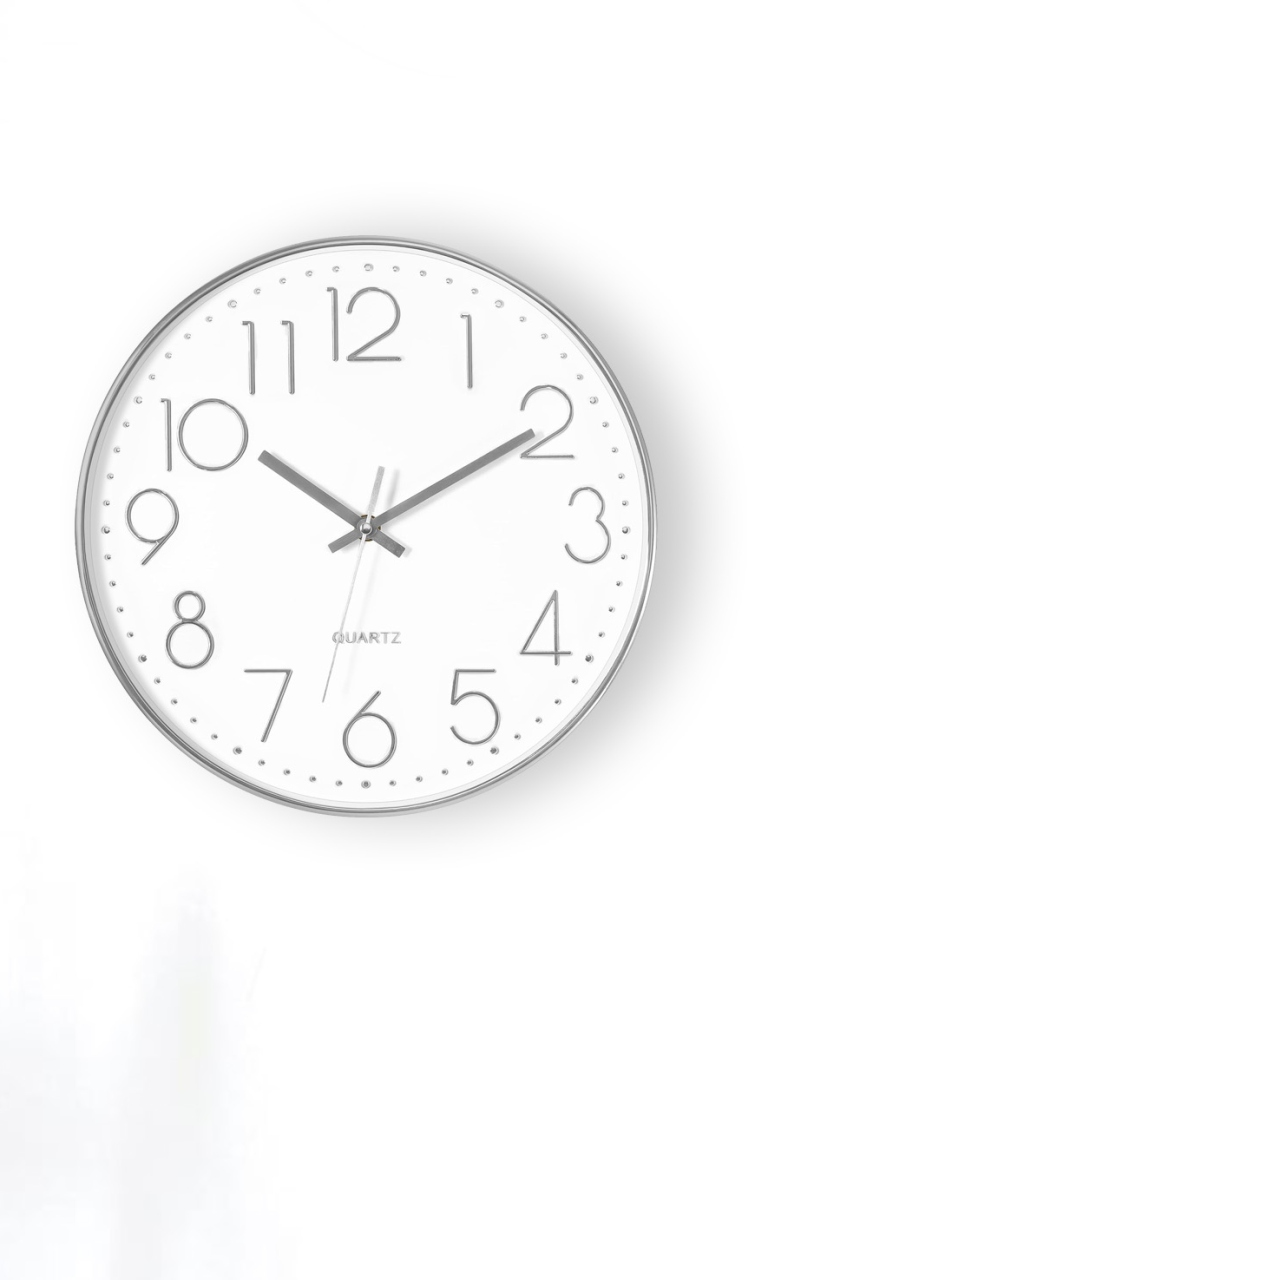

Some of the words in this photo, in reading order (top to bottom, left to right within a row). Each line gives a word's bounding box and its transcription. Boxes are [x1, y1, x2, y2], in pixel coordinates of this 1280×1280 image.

[241, 319, 296, 395] 11
[326, 286, 402, 362] 12
[460, 313, 474, 389] 1
[160, 397, 249, 472] 10
[520, 384, 575, 460] 2
[124, 487, 180, 566] 9
[564, 486, 612, 564] 3
[165, 590, 215, 669] 8
[331, 630, 402, 645] QUARTZ
[519, 589, 573, 666] 4
[243, 668, 294, 743] 7
[341, 690, 398, 768] 6
[449, 668, 502, 745] 5
